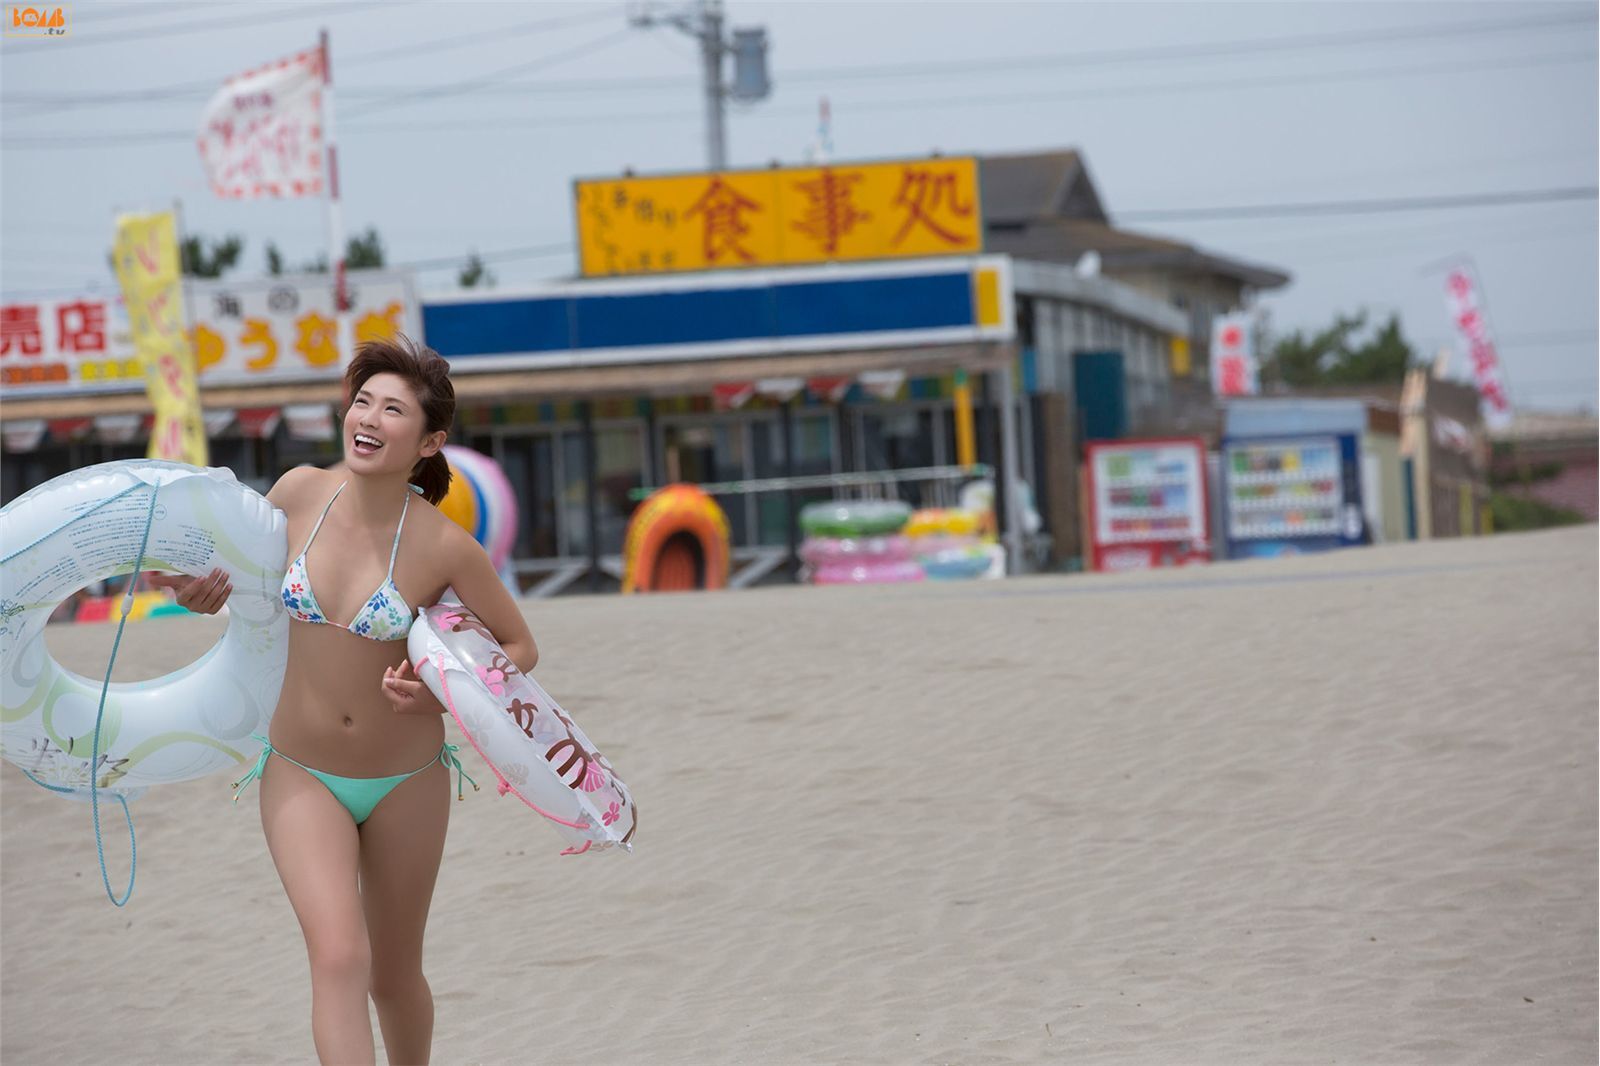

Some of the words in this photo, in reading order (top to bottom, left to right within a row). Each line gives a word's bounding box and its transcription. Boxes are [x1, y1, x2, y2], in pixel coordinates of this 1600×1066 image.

[683, 166, 972, 264] 食事処
[0, 302, 105, 356] 売店
